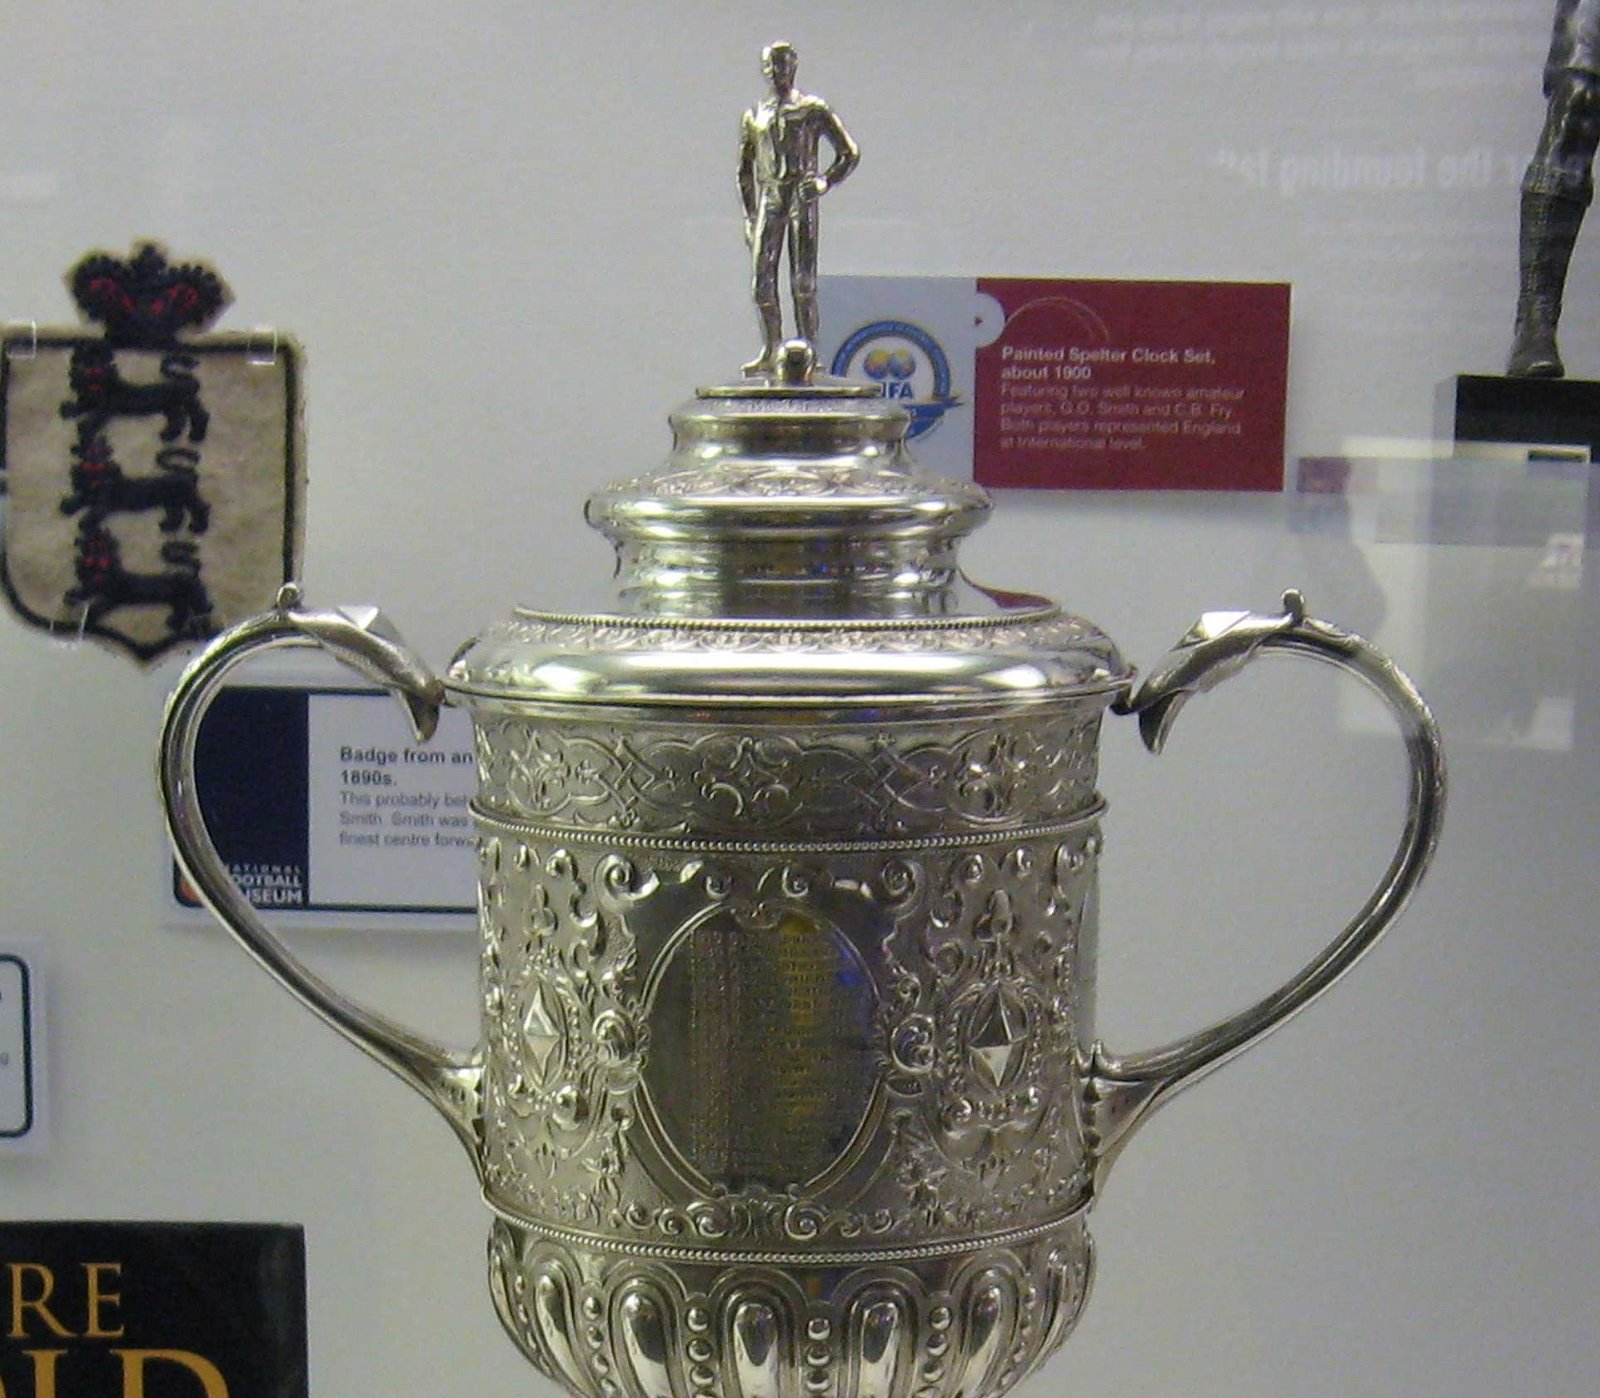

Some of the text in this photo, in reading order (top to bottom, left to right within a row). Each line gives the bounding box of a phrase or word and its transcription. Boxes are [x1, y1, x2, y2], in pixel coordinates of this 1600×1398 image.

[1001, 346, 1065, 361] Painted
[1069, 347, 1127, 364] Spelter
[1132, 348, 1178, 363] Clock
[1001, 366, 1092, 381] about 1900
[1001, 383, 1069, 400] Featuring
[1183, 420, 1242, 437] England
[340, 746, 473, 765] Badge from an
[341, 770, 398, 786] 1890s.
[340, 791, 371, 806] This
[375, 792, 440, 809] probably
[392, 812, 437, 827] Smith
[438, 817, 469, 828] was
[339, 831, 381, 846] finest
[384, 833, 431, 847] centre
[225, 863, 301, 874] ATIONAL
[231, 873, 302, 888] OOTBALL
[246, 888, 303, 904] SEUM
